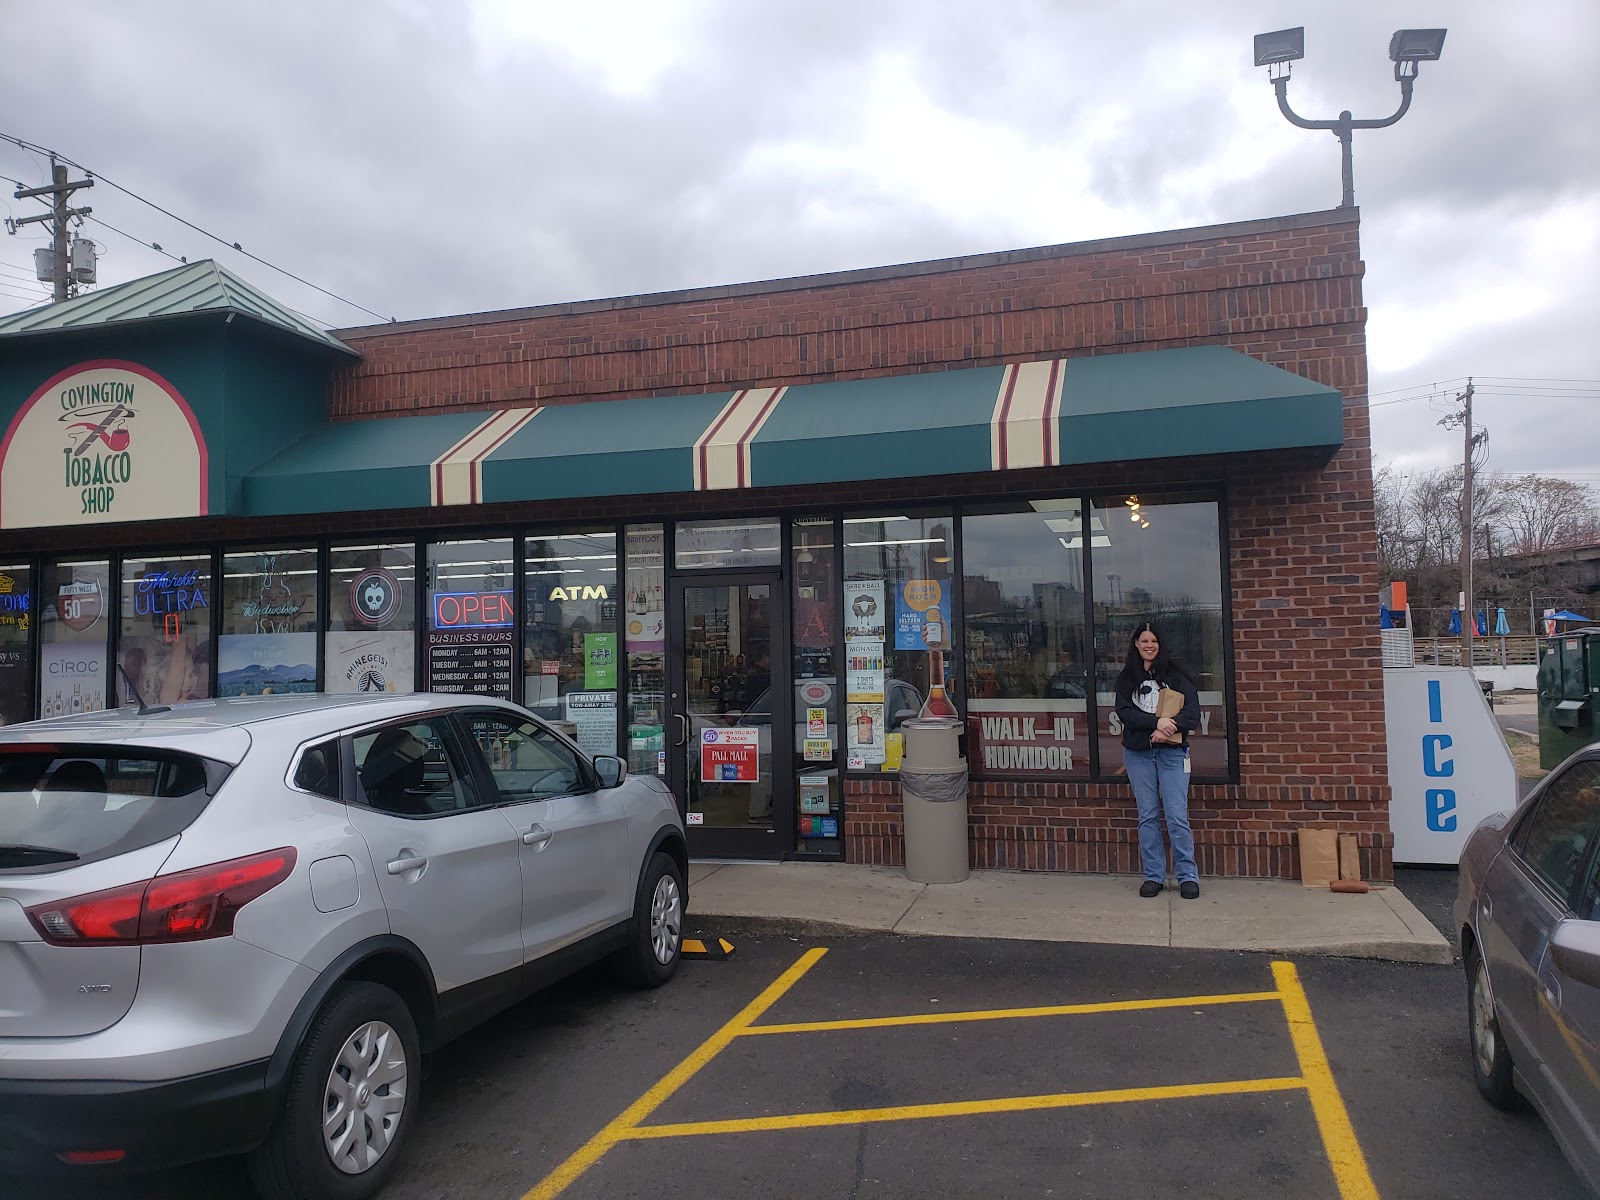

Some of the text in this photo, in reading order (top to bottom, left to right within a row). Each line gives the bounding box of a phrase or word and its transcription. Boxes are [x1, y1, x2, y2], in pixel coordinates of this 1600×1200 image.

[61, 382, 135, 411] COVINGTON
[63, 448, 131, 487] TOBACCO
[81, 486, 115, 514] SHOP
[79, 585, 92, 593] WEST
[549, 585, 608, 602] ATM
[64, 599, 81, 619] 50
[135, 588, 207, 615] ULTRA
[241, 602, 300, 617] Budweiser
[429, 632, 513, 643] BUSINESS HOURS
[432, 649, 458, 657] MONDAY
[346, 654, 388, 680] RHINEGEIST
[432, 673, 470, 681] WEDNESDAY
[432, 685, 464, 693] THURSDAY
[725, 735, 731, 743] 2
[711, 750, 749, 761] PALL MALL
[985, 746, 1073, 770] HUMIDOR
